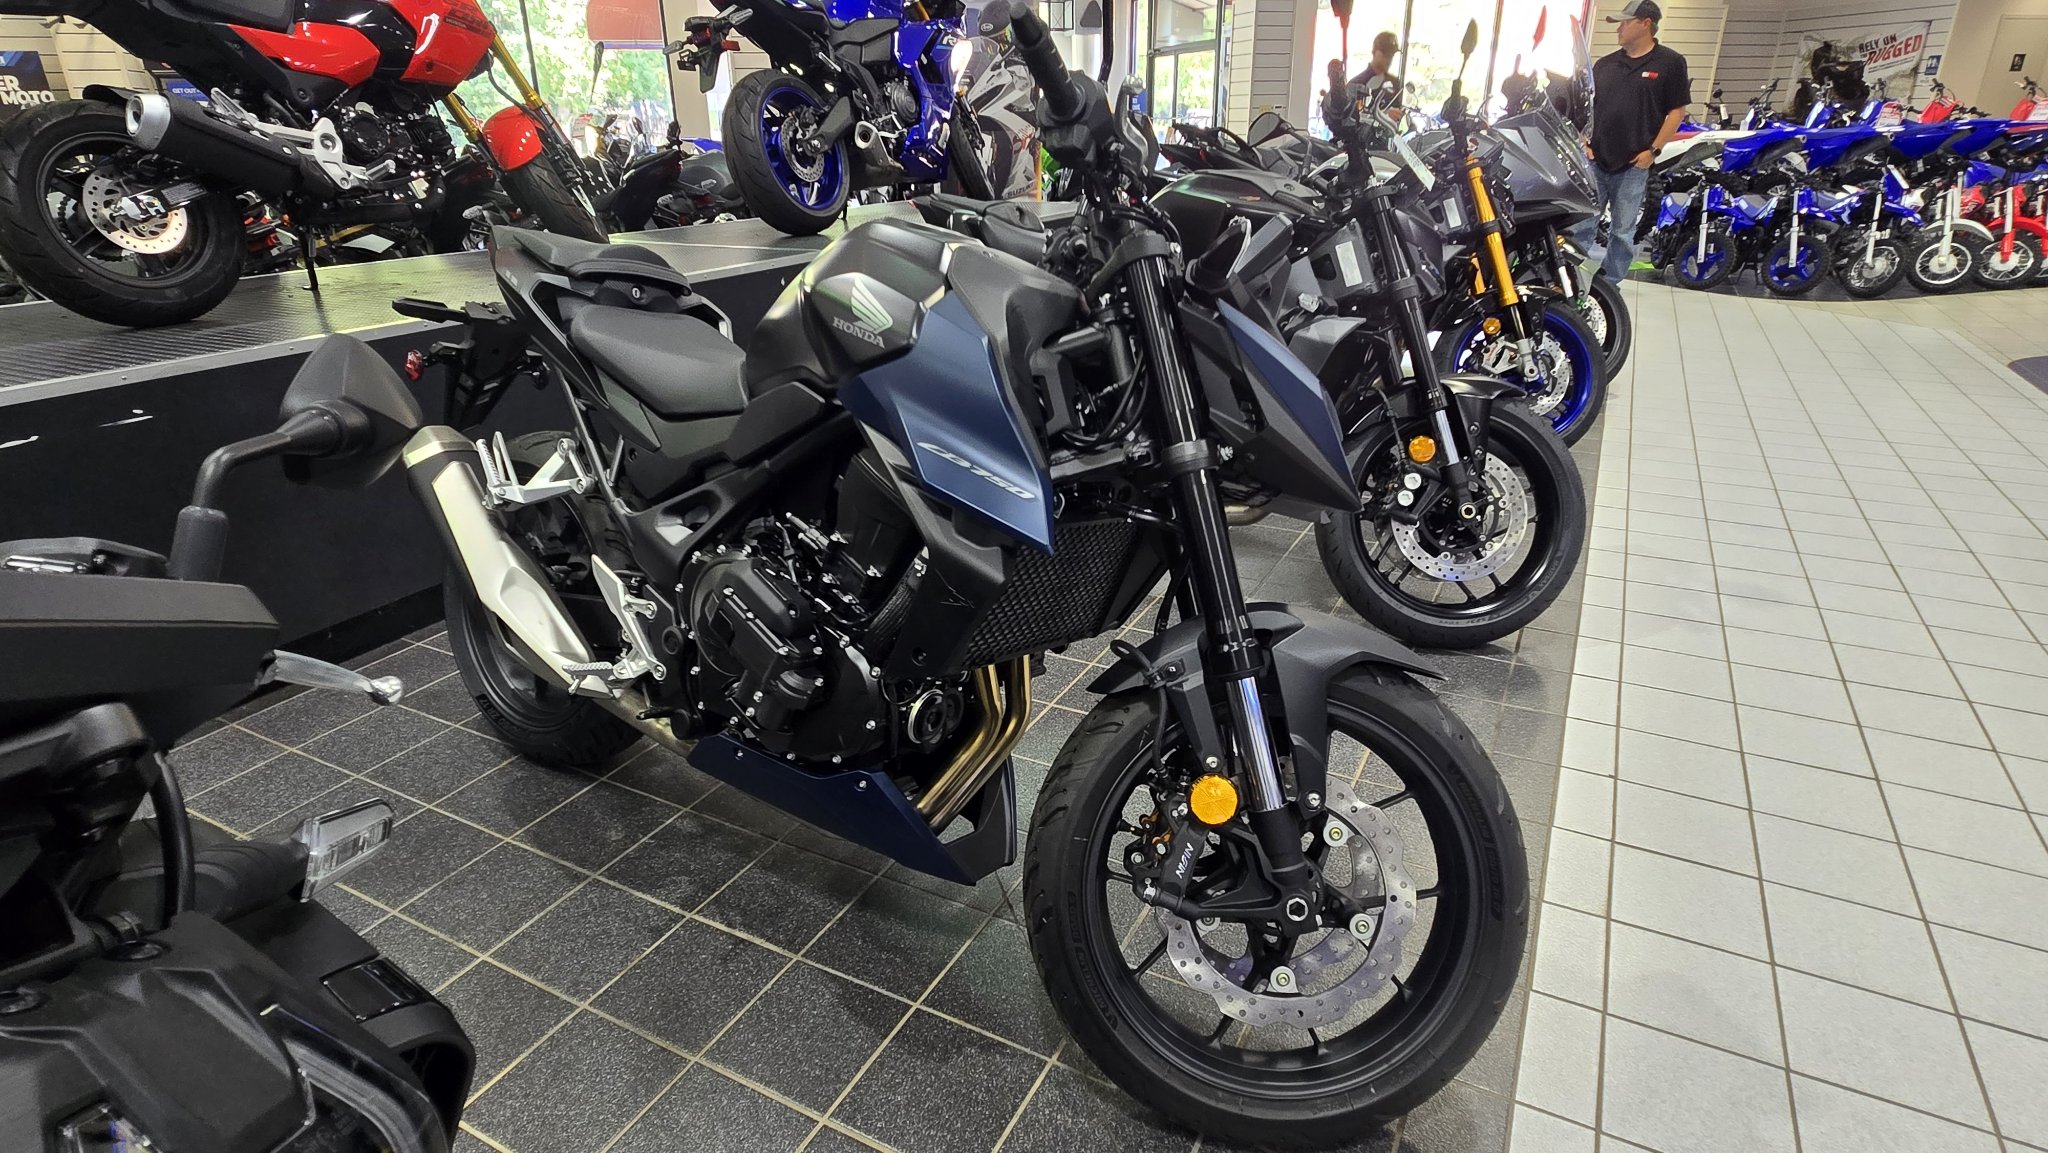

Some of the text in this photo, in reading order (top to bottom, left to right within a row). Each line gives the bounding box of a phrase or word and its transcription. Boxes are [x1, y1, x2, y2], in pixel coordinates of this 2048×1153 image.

[1859, 33, 1897, 53] RELY ON
[1866, 34, 1922, 65] RUGGED
[833, 316, 885, 349] HONDA
[917, 442, 1035, 499] CB750
[1175, 842, 1194, 879] NISSIN
